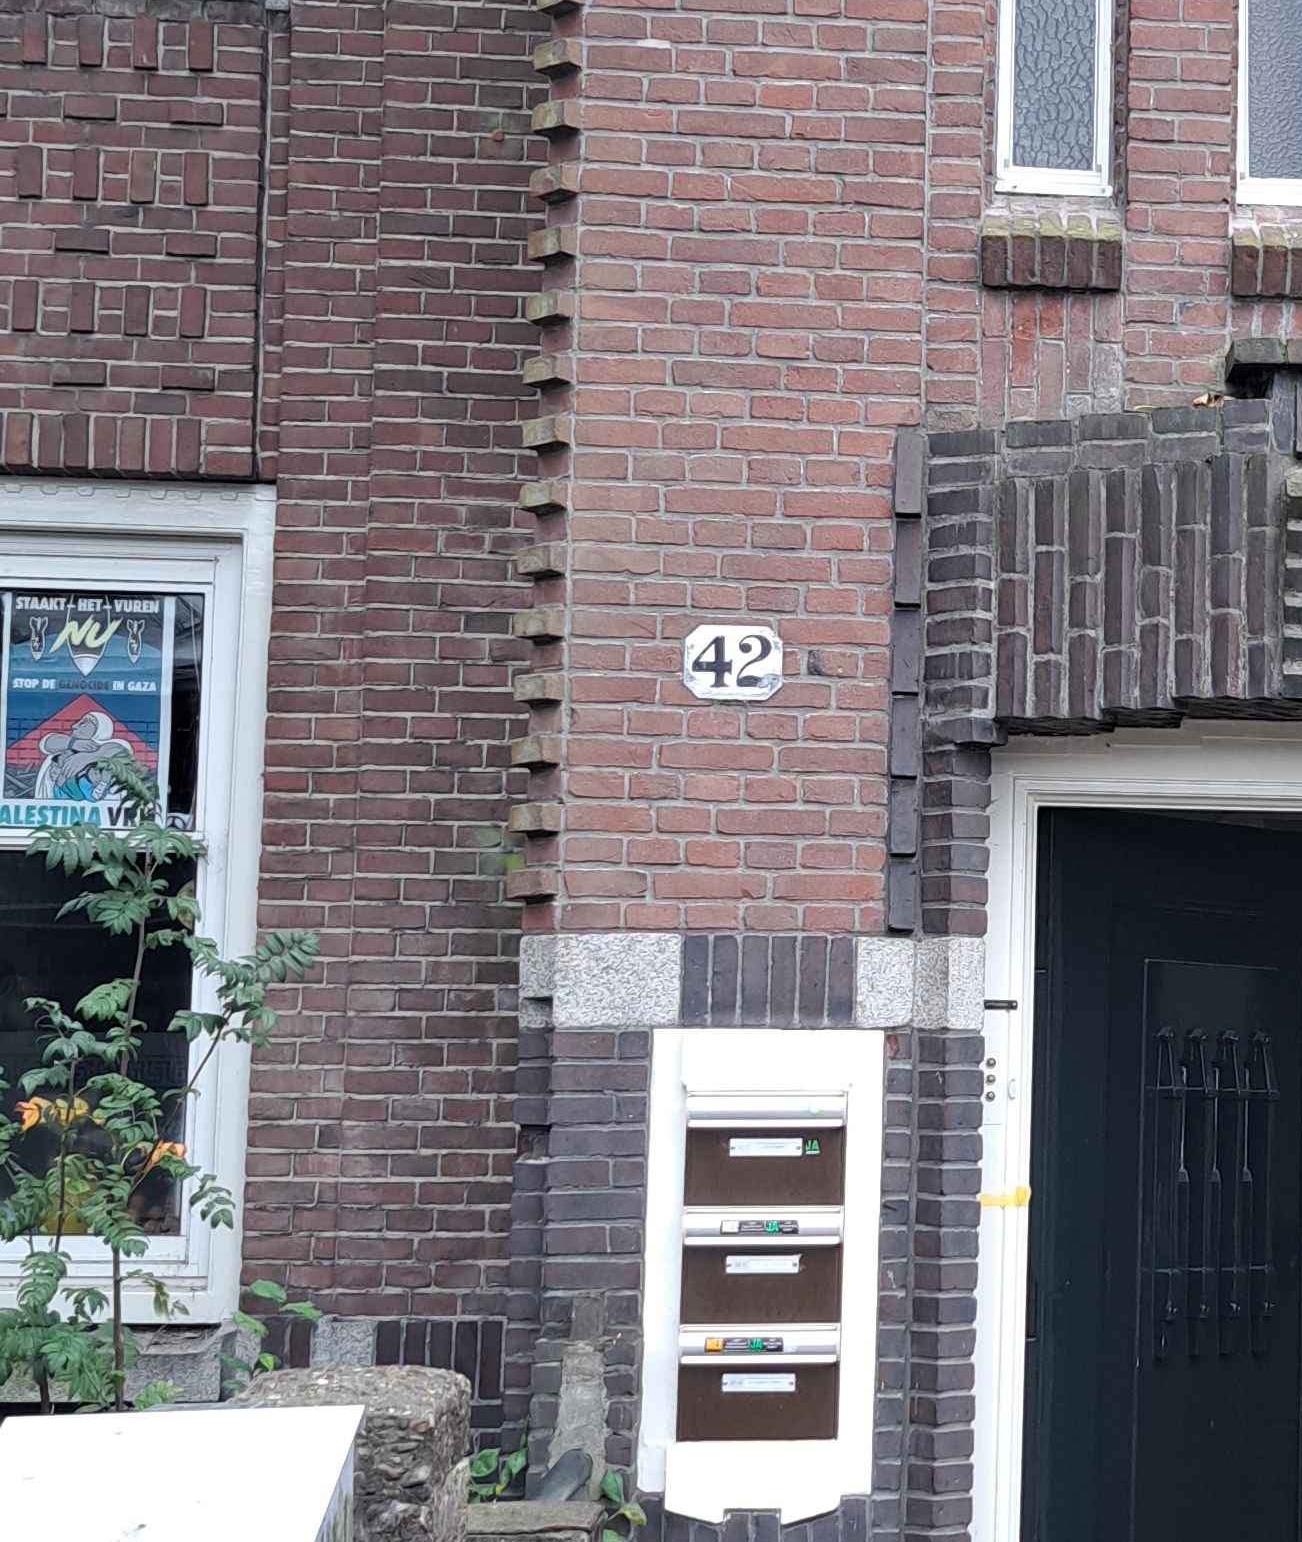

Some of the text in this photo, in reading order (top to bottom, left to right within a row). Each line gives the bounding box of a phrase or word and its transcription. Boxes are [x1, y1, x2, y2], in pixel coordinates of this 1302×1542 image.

[50, 614, 123, 653] NU
[692, 635, 773, 688] 42
[13, 678, 40, 689] STOP
[42, 678, 56, 689] DE
[113, 680, 125, 691] IN
[128, 680, 157, 692] GAZA
[0, 804, 101, 827] ALESTINA
